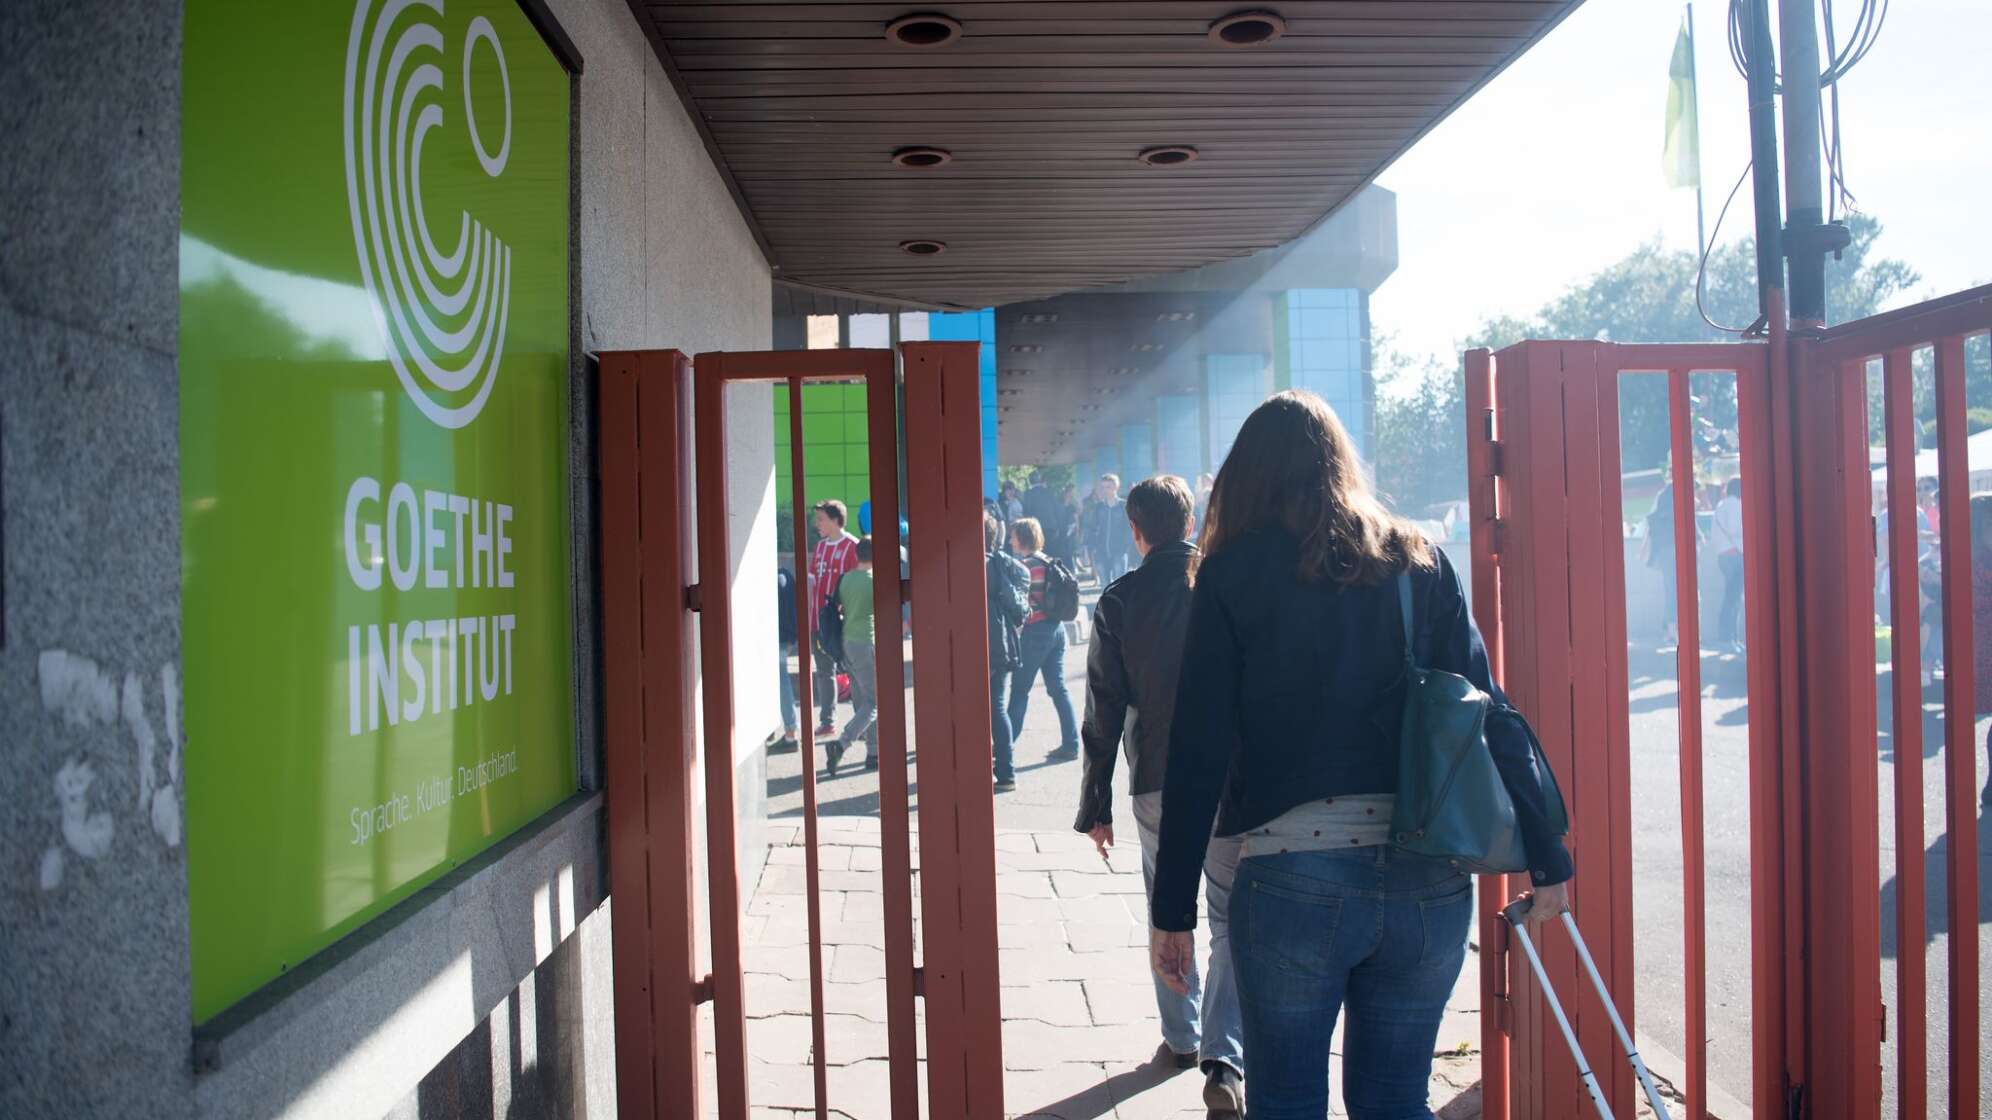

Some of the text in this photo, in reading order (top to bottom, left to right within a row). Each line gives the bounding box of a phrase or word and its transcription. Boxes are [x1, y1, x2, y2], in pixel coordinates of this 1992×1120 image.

[344, 476, 515, 592] GOETHE
[348, 614, 516, 736] INSTITUT
[351, 745, 518, 845] Sprache. Kultur. Deutschland.
